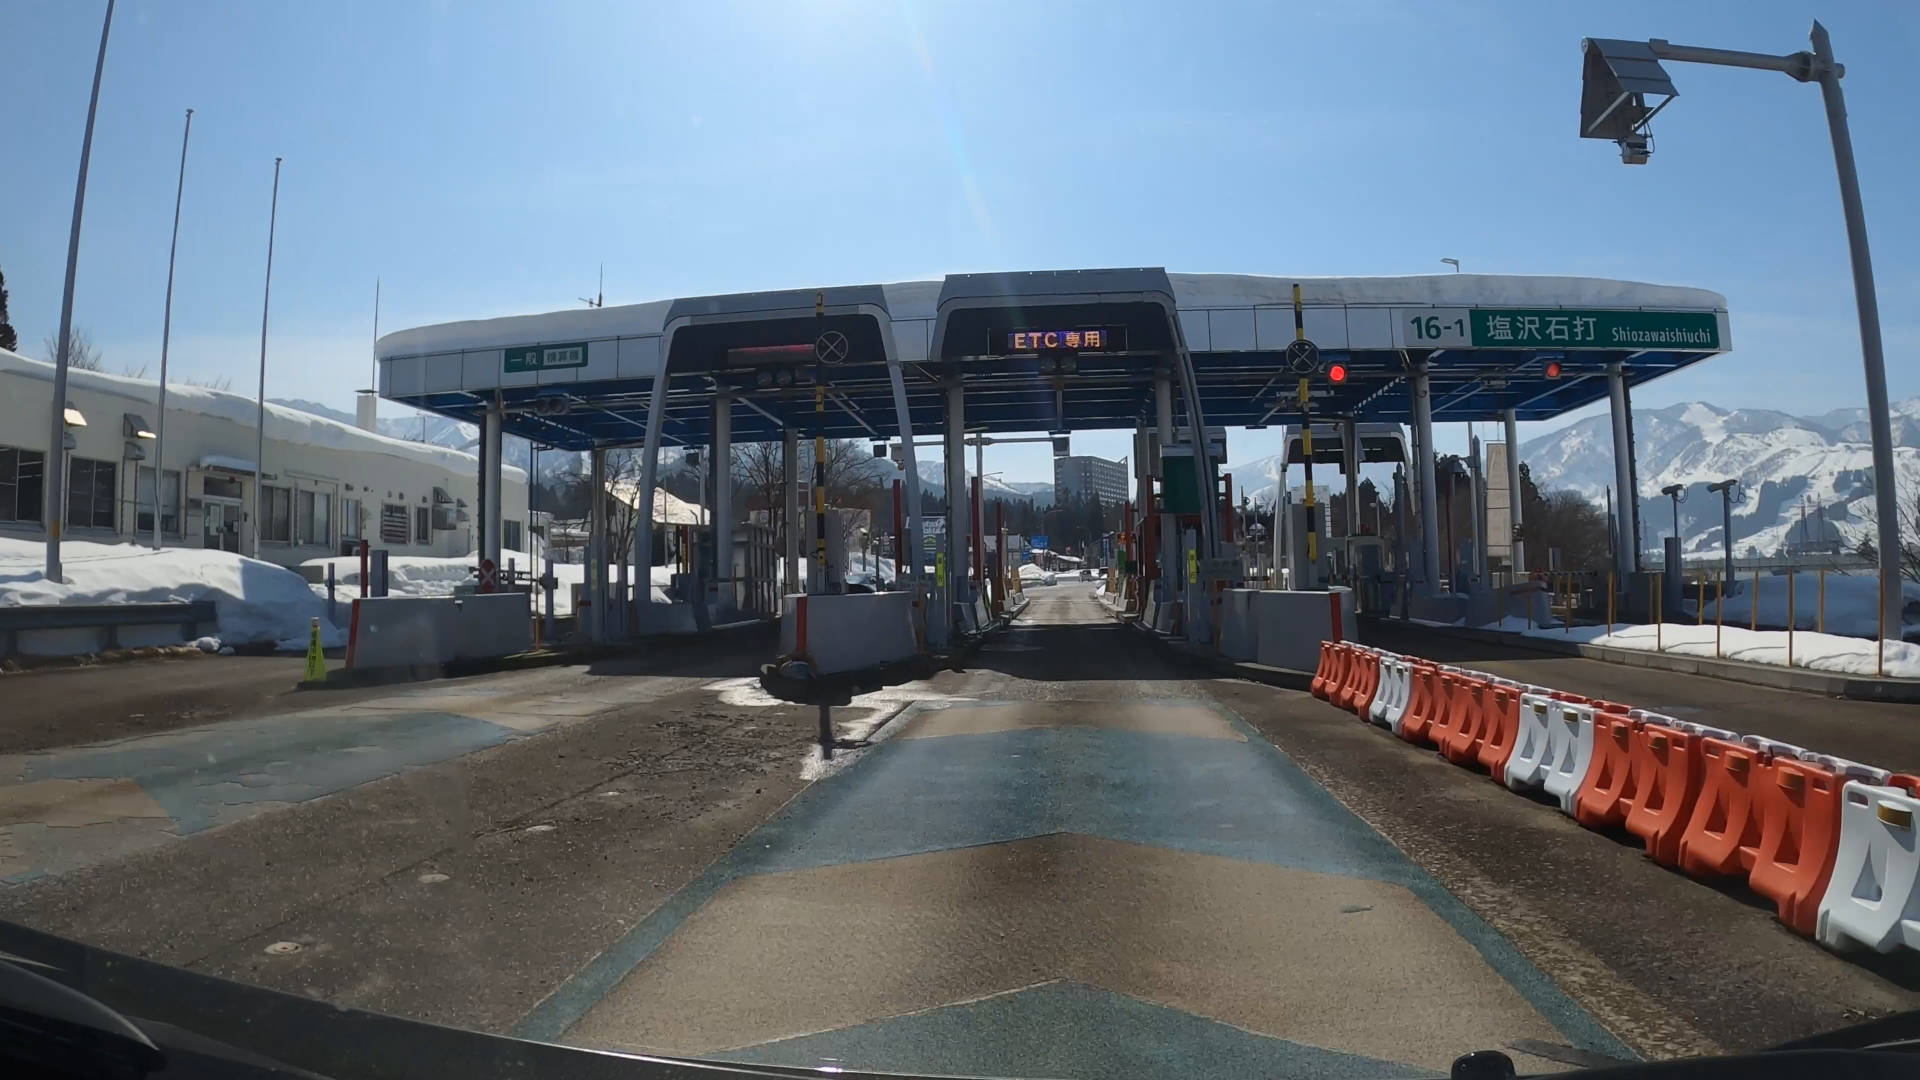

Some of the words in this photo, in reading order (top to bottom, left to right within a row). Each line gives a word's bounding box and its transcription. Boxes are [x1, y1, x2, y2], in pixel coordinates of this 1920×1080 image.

[1410, 316, 1464, 339] 16-1
[1487, 315, 1597, 341] 塩沢石打
[1612, 327, 1711, 343] Shiozawaishiuchi
